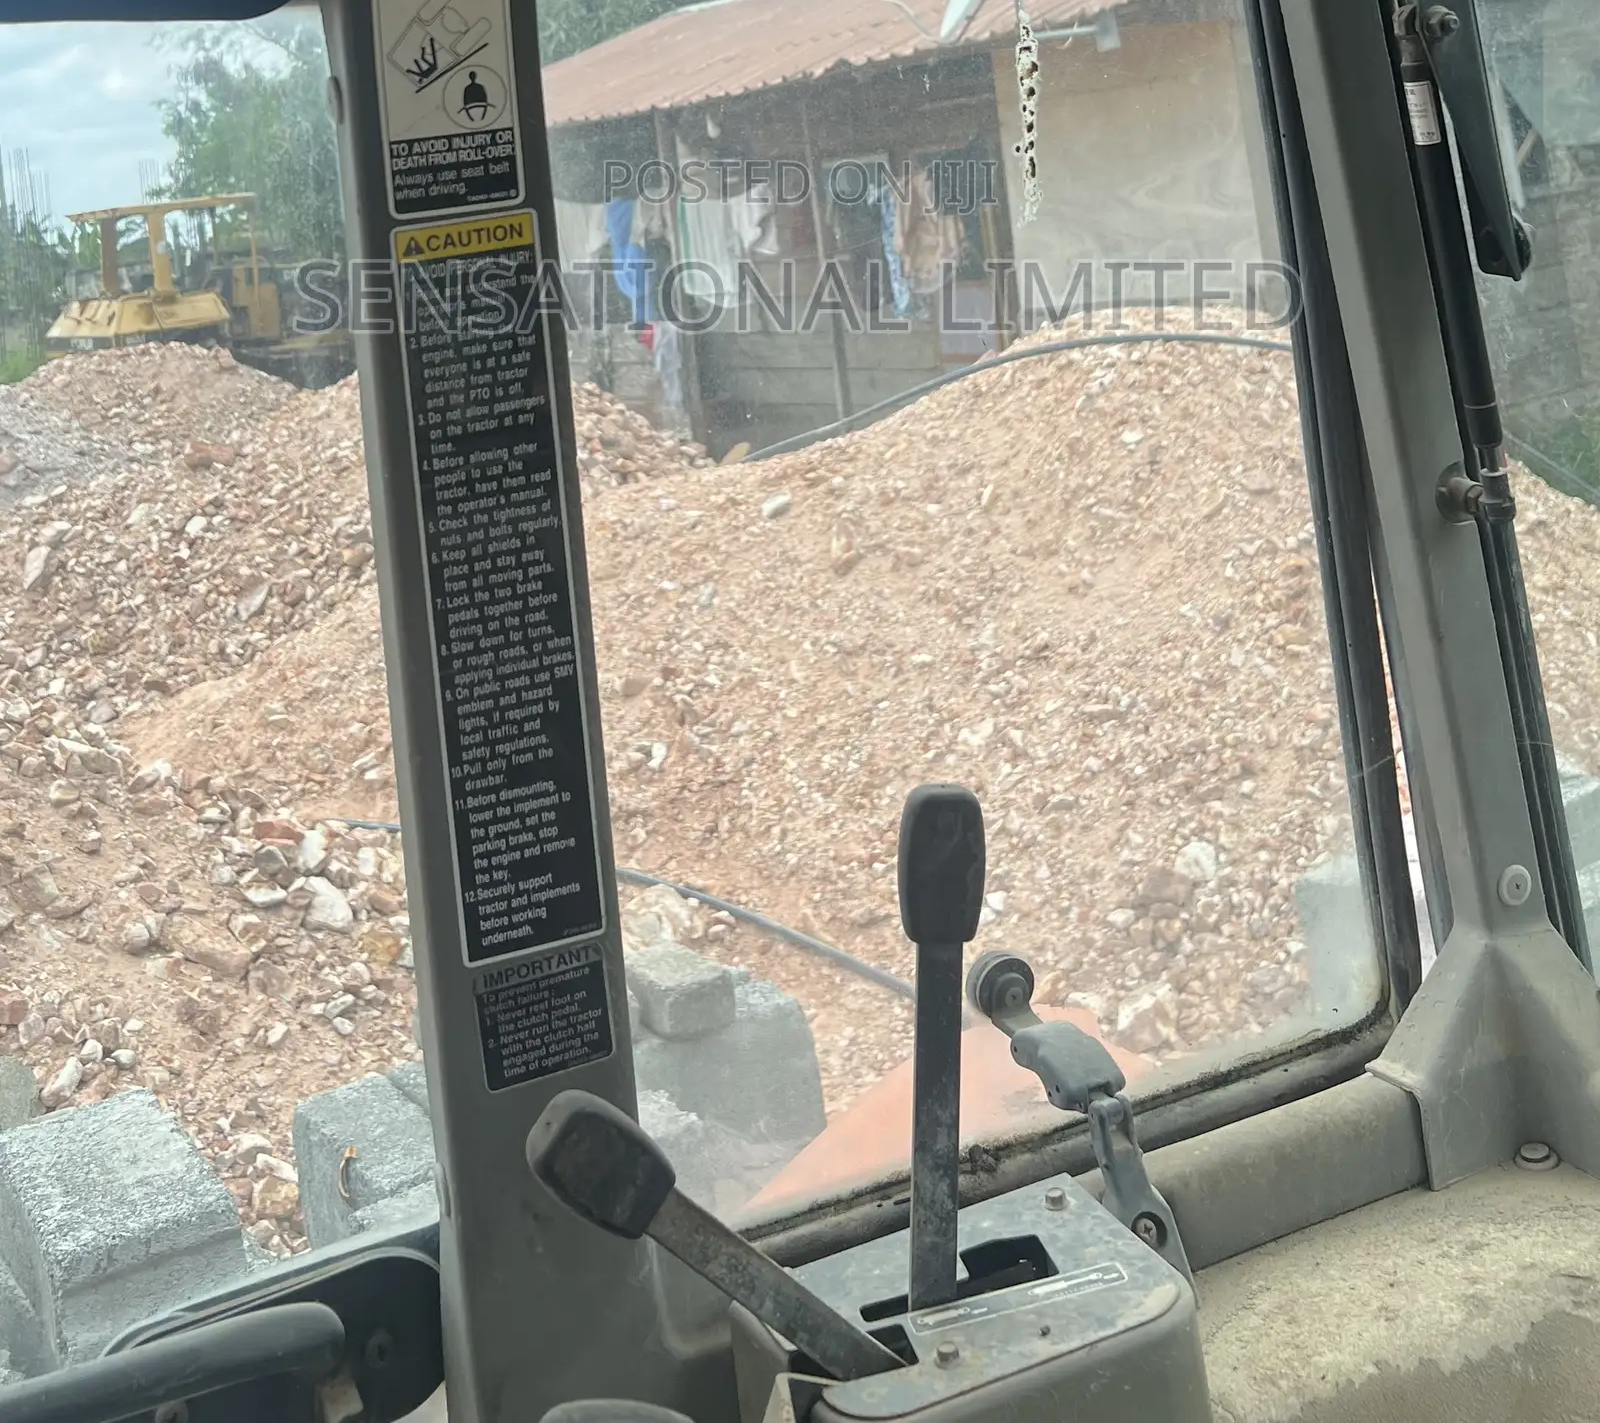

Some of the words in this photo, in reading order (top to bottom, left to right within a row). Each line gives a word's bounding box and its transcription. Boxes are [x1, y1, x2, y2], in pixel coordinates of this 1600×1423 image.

[391, 143, 409, 156] TO
[412, 139, 449, 154] AVOID
[452, 133, 492, 148] INJURY
[495, 131, 512, 143] OR
[392, 156, 427, 170] DEATH
[428, 150, 457, 166] FROM
[395, 173, 434, 186] Always
[437, 169, 457, 181] use
[461, 165, 484, 178] seat
[489, 161, 510, 174] belt
[396, 187, 425, 199] when
[428, 182, 468, 196] driving.
[426, 222, 524, 252] CAUTION
[420, 334, 452, 347] Before
[463, 343, 488, 356] make
[492, 339, 514, 352] sure
[518, 334, 536, 346] that
[424, 362, 468, 378] everyone
[512, 351, 531, 363] safe
[425, 378, 466, 393] distance
[470, 374, 492, 385] from
[497, 367, 529, 380] tractor
[427, 395, 444, 409] and
[449, 393, 465, 404] the
[469, 387, 490, 400] PTO
[428, 412, 441, 424] Do
[494, 395, 545, 415] passengers
[430, 429, 442, 439] on
[447, 424, 462, 436] the
[467, 419, 499, 433] tractor
[518, 413, 535, 426] any
[433, 456, 464, 470] Before
[469, 447, 508, 464] allowing
[513, 442, 537, 455] other
[434, 470, 466, 488] people
[471, 468, 480, 478] to
[486, 464, 503, 476] use
[508, 460, 523, 472] the
[475, 480, 498, 493] have
[502, 476, 526, 488] them
[530, 468, 552, 482] read
[437, 504, 452, 516] the
[439, 517, 468, 531] Check
[474, 514, 488, 524] the
[494, 504, 536, 522] tightness
[542, 500, 551, 512] of
[441, 534, 461, 546] nuts
[467, 528, 484, 542] and
[489, 524, 512, 537] bolts
[442, 548, 466, 562] Keep
[472, 544, 482, 557] all
[488, 539, 521, 554] shields
[526, 535, 535, 546] in
[444, 564, 468, 580] place
[474, 559, 492, 572] and
[496, 554, 516, 567] stay
[522, 549, 545, 562] away
[445, 580, 467, 592] from
[472, 574, 483, 587] all
[489, 569, 523, 584] moving
[446, 594, 469, 608] Lock
[474, 591, 490, 602] the
[495, 587, 512, 598] two
[517, 580, 542, 594] brake
[448, 608, 480, 626] pedals
[484, 600, 523, 616] together
[528, 593, 558, 607] before
[450, 624, 482, 639] driving
[488, 620, 500, 631] on
[505, 616, 520, 627] the
[451, 641, 474, 654] Slow
[480, 634, 504, 648] down
[510, 630, 522, 642] for
[453, 659, 462, 670] or
[467, 651, 494, 666] rough
[533, 642, 542, 652] or
[547, 636, 571, 649] when
[455, 668, 493, 684] applying
[496, 657, 539, 674] individual
[456, 687, 469, 699] On
[473, 682, 501, 698] public
[505, 675, 530, 689] roads
[534, 671, 550, 683] use
[554, 664, 574, 679] SMV
[457, 699, 494, 716] emblem
[500, 693, 516, 706] and
[522, 685, 552, 701] hazard
[505, 702, 543, 720] required
[548, 700, 559, 712] by
[460, 731, 483, 746] local
[488, 724, 518, 740] traffic
[524, 719, 540, 732] and
[462, 746, 490, 761] safety
[487, 758, 506, 771] only
[512, 752, 534, 765] from
[538, 748, 554, 759] the
[469, 810, 494, 823] lower
[497, 806, 511, 817] the
[514, 793, 559, 814] implement
[562, 792, 571, 802] to
[471, 828, 485, 839] the
[525, 814, 539, 826] set
[542, 811, 555, 822] the
[472, 838, 506, 856] parking
[539, 826, 558, 839] stop
[474, 858, 488, 869] the
[491, 850, 521, 866] engine
[524, 844, 540, 858] and
[543, 838, 575, 853] remove
[475, 874, 490, 885] the
[518, 873, 552, 891] support
[479, 900, 508, 916] tractor
[511, 894, 528, 908] and
[531, 882, 580, 903] implements
[480, 916, 509, 930] before
[512, 906, 547, 922] working
[483, 946, 593, 988] IMPORTANT
